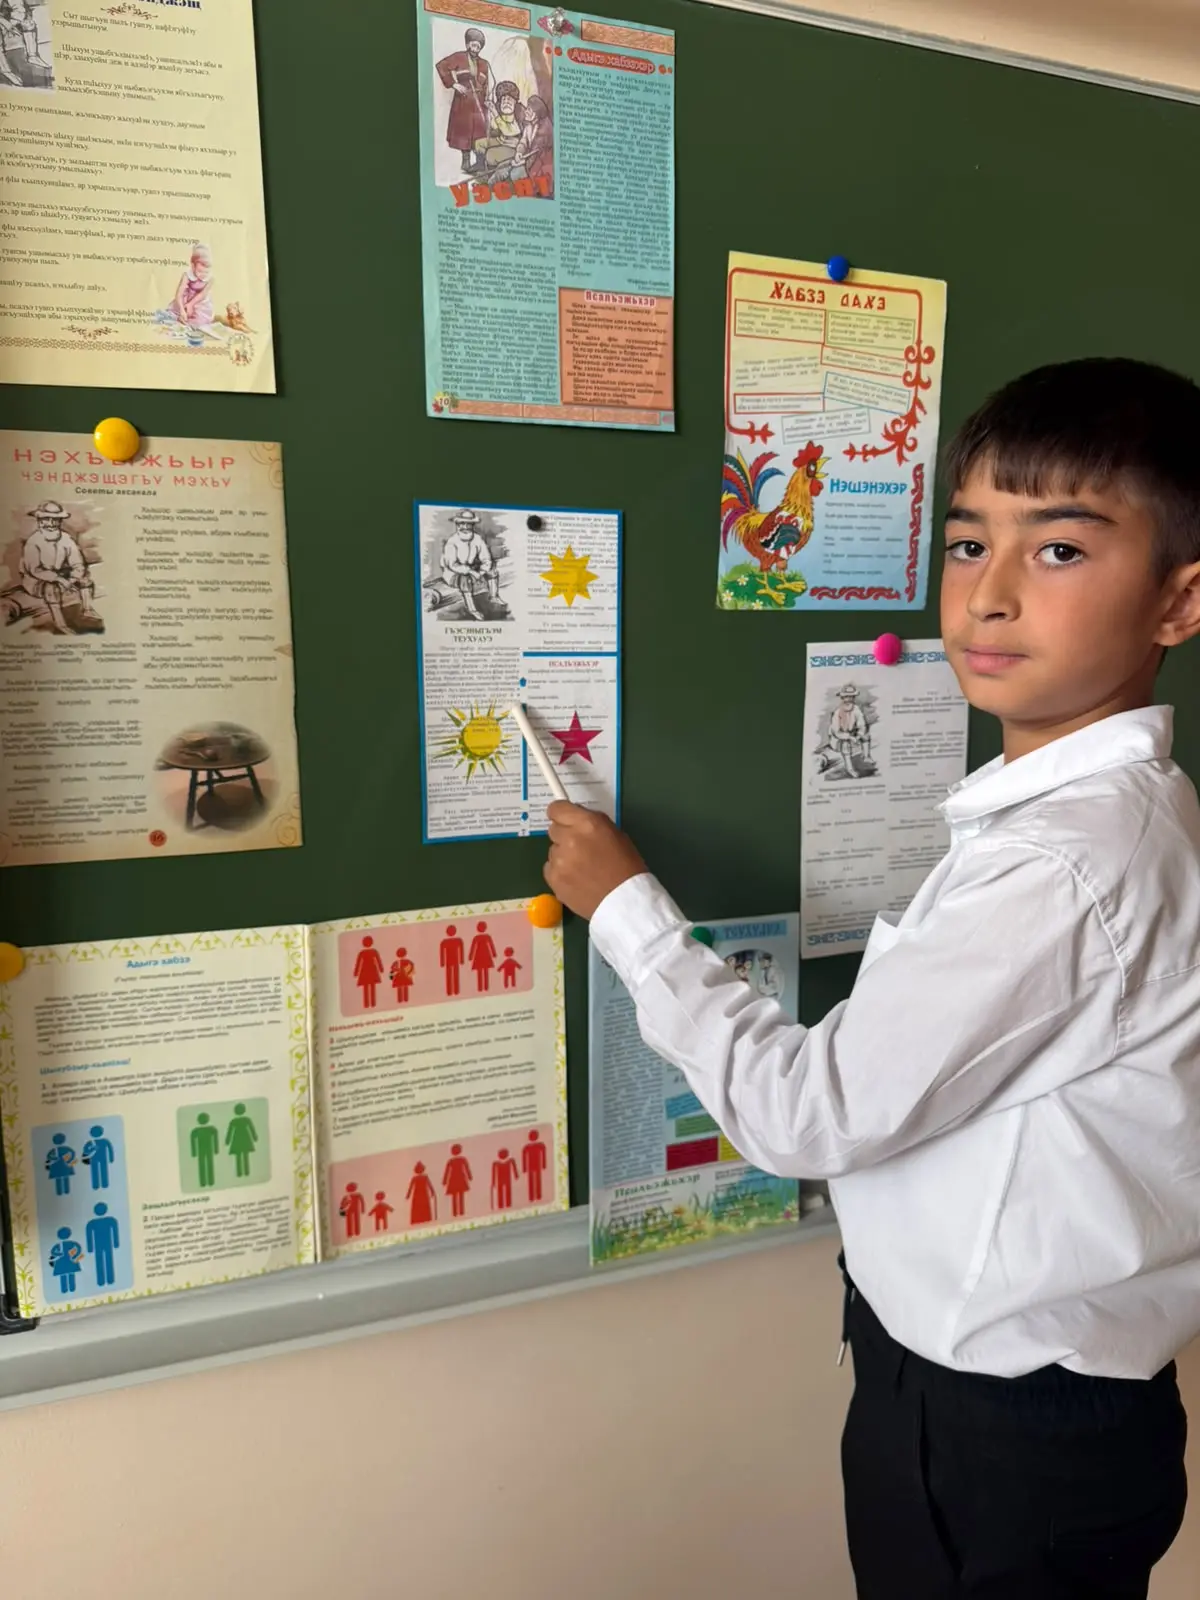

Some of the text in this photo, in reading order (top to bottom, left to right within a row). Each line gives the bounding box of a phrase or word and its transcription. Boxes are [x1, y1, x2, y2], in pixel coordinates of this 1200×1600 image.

[571, 48, 655, 74] Адыгэ хабзэхэр
[585, 290, 656, 306] Псалъэжьхэр
[769, 281, 826, 304] ХАБЗЭ
[22, 471, 232, 487] ЧЭНДЖЭЩЭГЪУ МЭХЪУ
[76, 487, 158, 498] Советы аксакала
[126, 956, 191, 970] Адыгэ хабзэ
